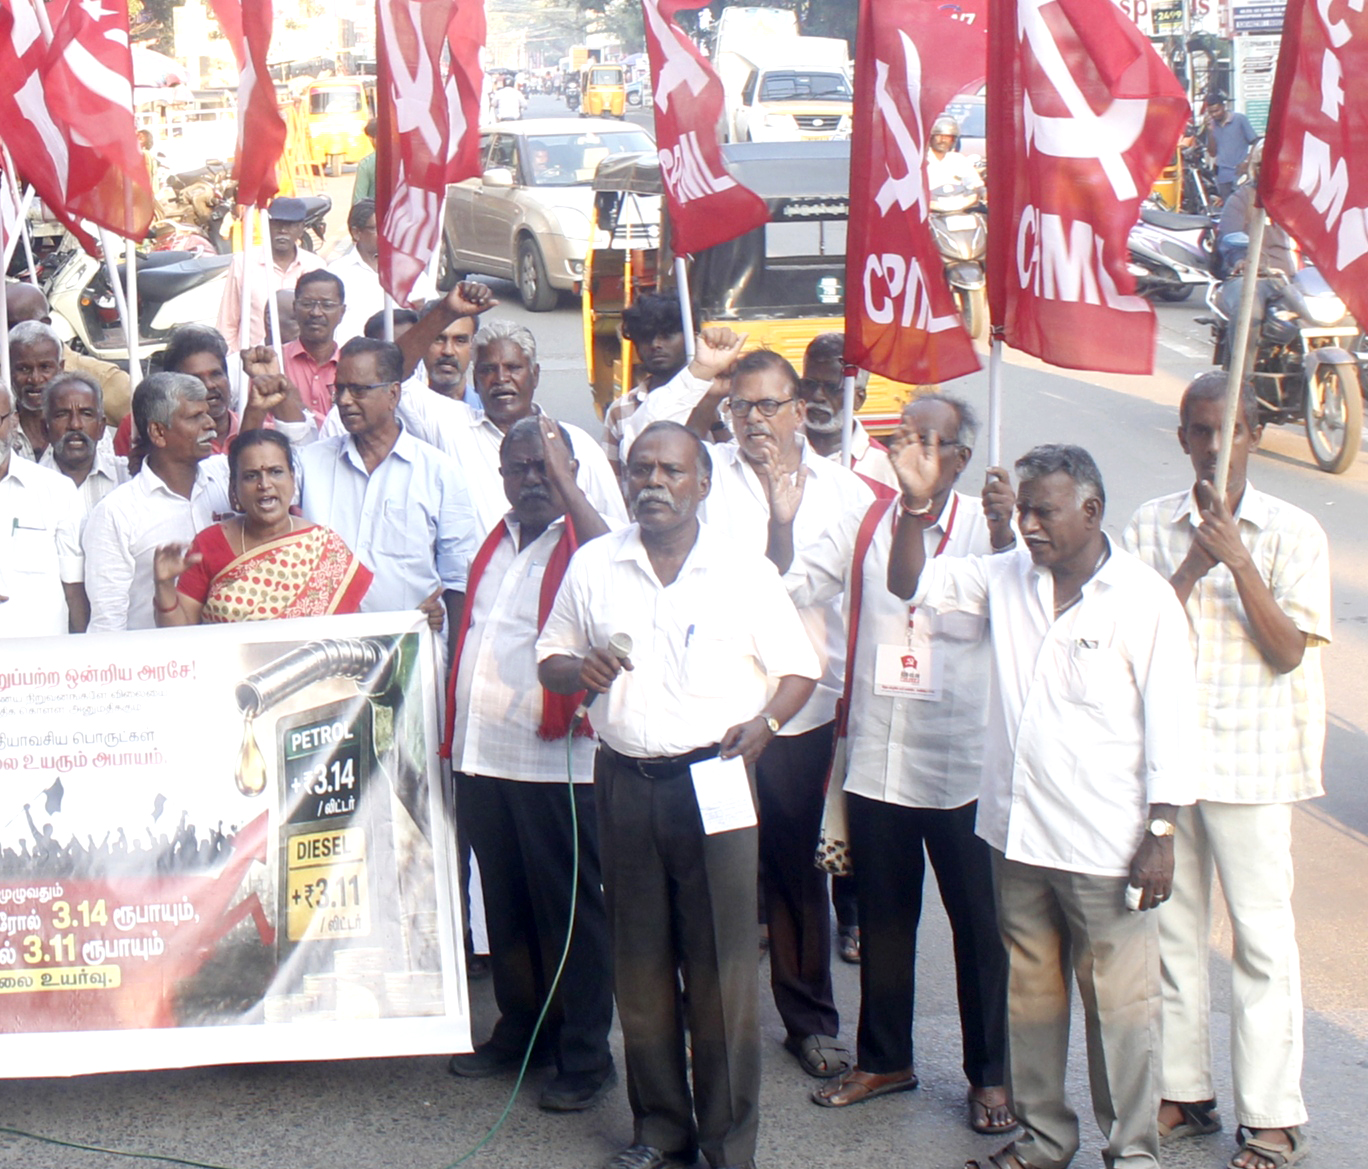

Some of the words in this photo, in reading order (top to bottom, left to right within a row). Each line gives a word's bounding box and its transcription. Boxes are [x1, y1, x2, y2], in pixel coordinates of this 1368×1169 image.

[64, 663, 133, 690] ஒன்றிய
[136, 660, 197, 683] அரசே!
[72, 728, 155, 748] பொருட்கள்
[291, 720, 354, 752] PETROL
[23, 750, 89, 773] உயரும்
[296, 834, 352, 861] DIESEL
[51, 898, 108, 929] 3.14
[112, 895, 200, 931] ரூபாயும்,
[22, 933, 76, 964] 3.11
[81, 929, 165, 966] ரூபாயும்
[39, 968, 113, 989] உயர்வு.
